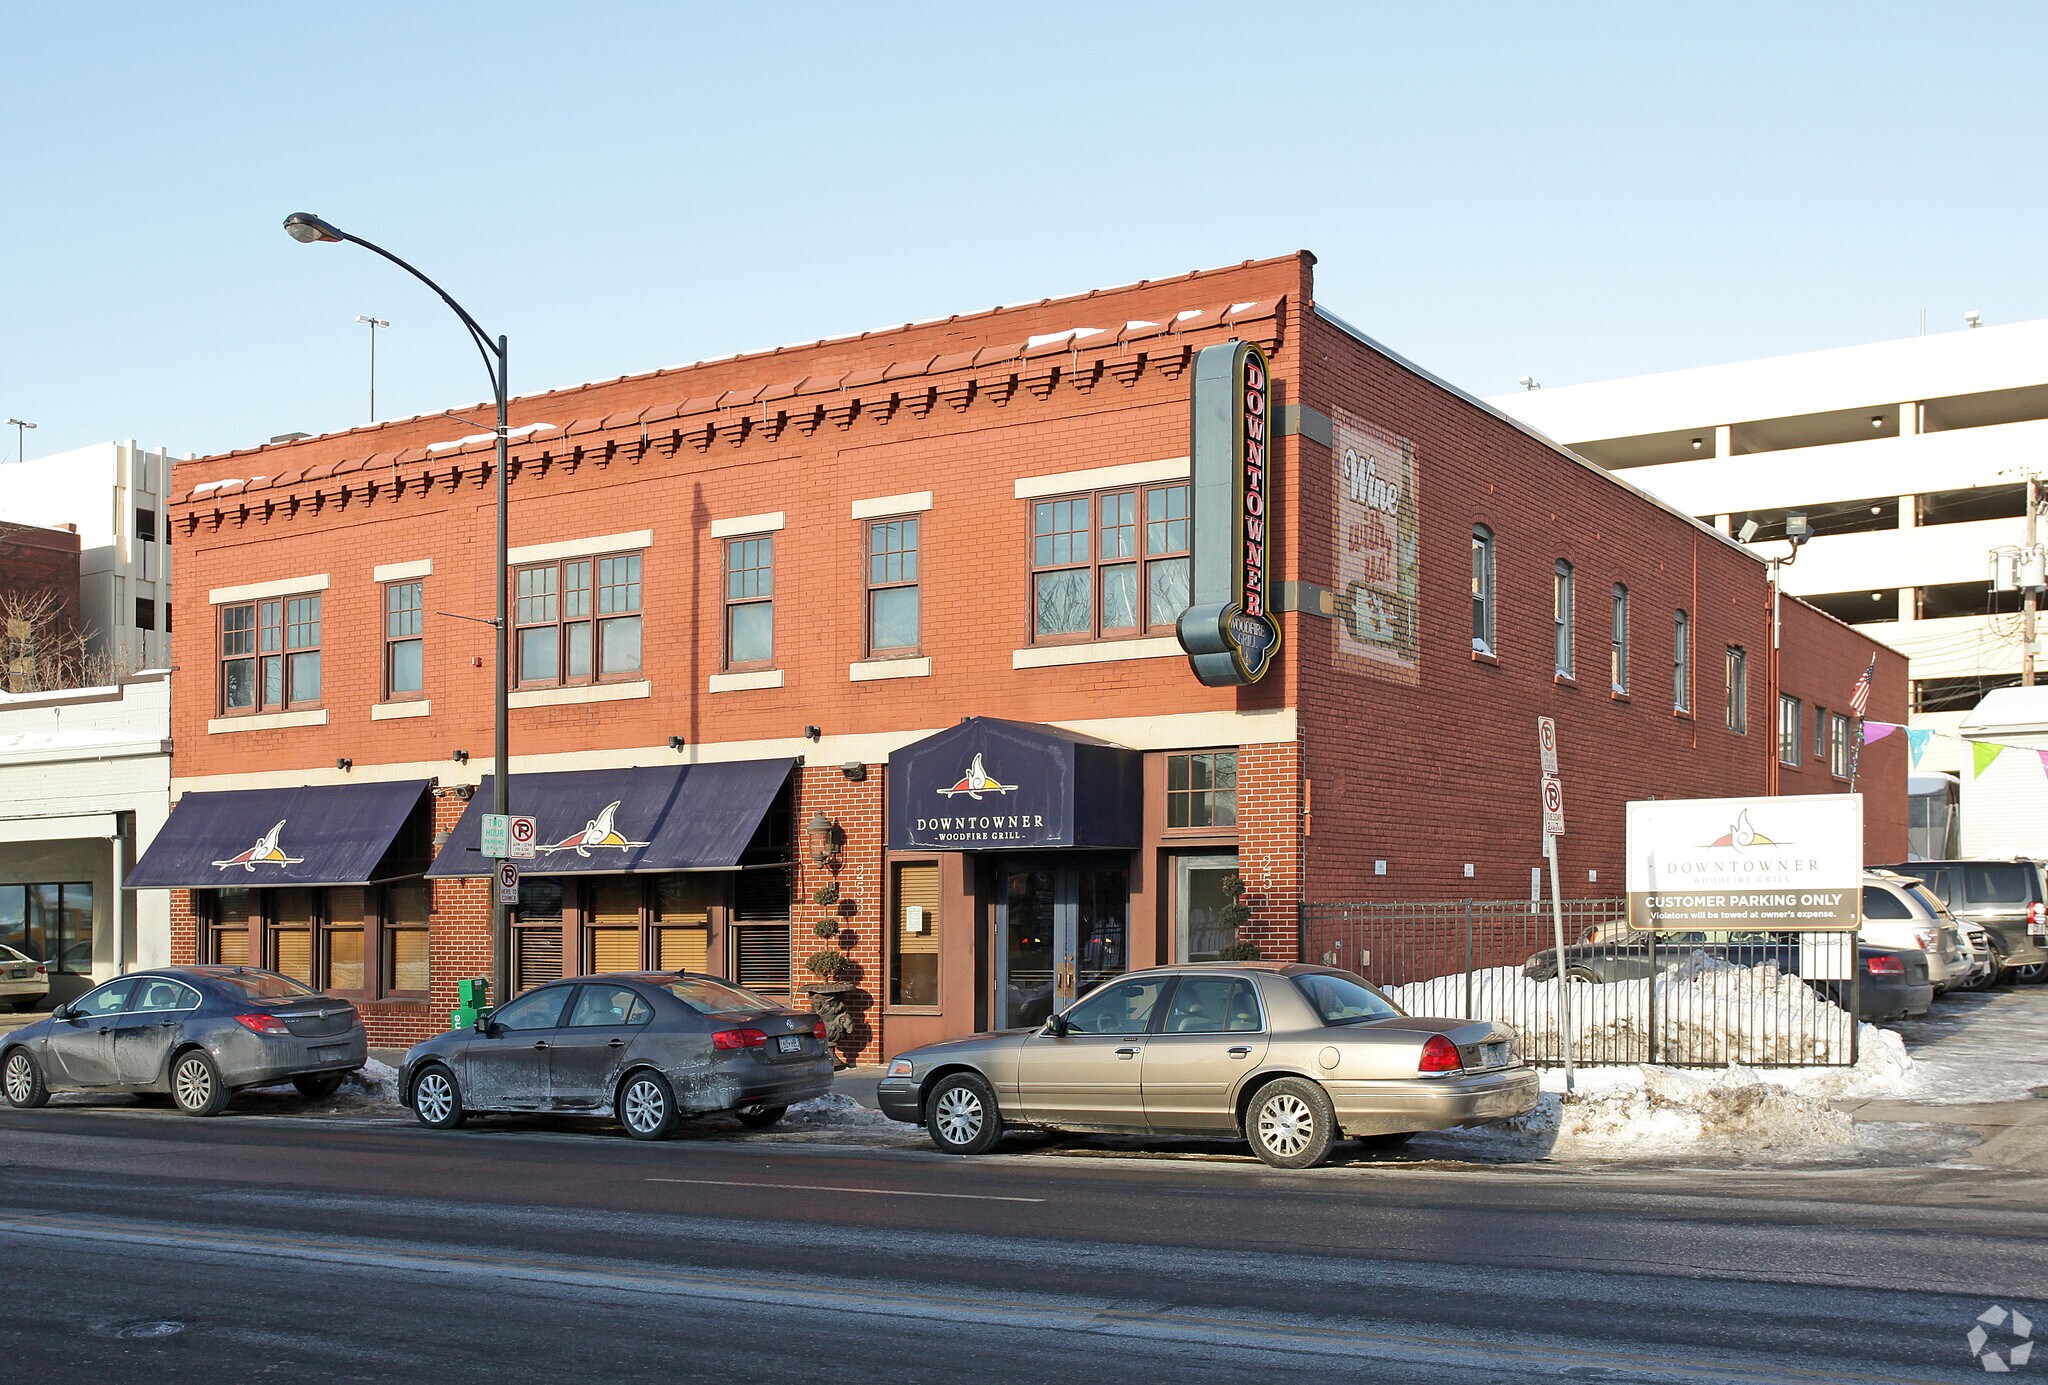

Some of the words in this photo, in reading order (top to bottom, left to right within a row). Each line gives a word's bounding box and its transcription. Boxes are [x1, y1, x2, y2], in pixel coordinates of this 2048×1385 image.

[1344, 448, 1399, 515] Wine
[1245, 363, 1263, 617] DOWNTOWNER
[1230, 618, 1265, 638] WOODFIRE
[1238, 633, 1258, 648] GRILL
[488, 819, 502, 828] TWO
[916, 814, 1044, 831] DOWNTOWNER
[486, 829, 504, 837] HOUR
[1667, 859, 1820, 874] DOWNTOWNER
[856, 865, 864, 912] 253
[1645, 896, 1726, 908] CUSTOMER
[1729, 894, 1796, 907] PARKING
[1800, 893, 1842, 906] ONLY
[1650, 911, 1689, 920] Violators
[1690, 911, 1705, 919] will
[1707, 911, 1719, 919] be
[1721, 911, 1747, 919] towed
[1761, 910, 1795, 919] owner's
[1797, 911, 1836, 920] expense.
